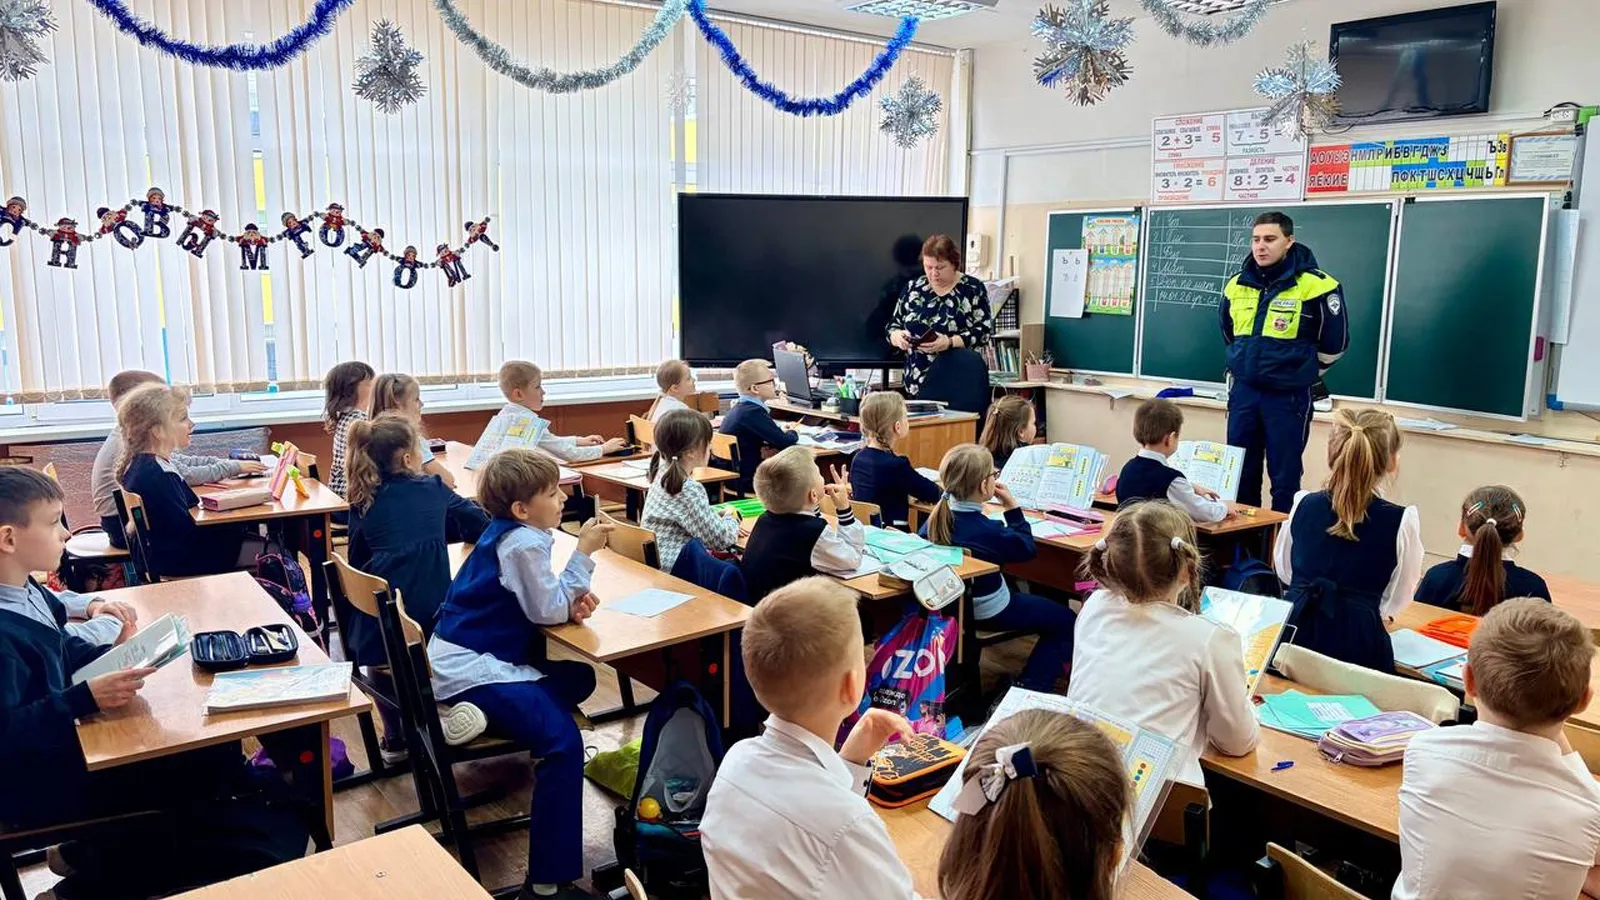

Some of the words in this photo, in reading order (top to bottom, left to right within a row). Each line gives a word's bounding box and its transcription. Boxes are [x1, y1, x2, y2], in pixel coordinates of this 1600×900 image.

[1212, 132, 1221, 143] 5
[1260, 128, 1269, 139] 5
[1207, 176, 1217, 187] 6
[1233, 175, 1244, 186] 8
[1259, 174, 1269, 185] 2
[1285, 173, 1296, 184] 4
